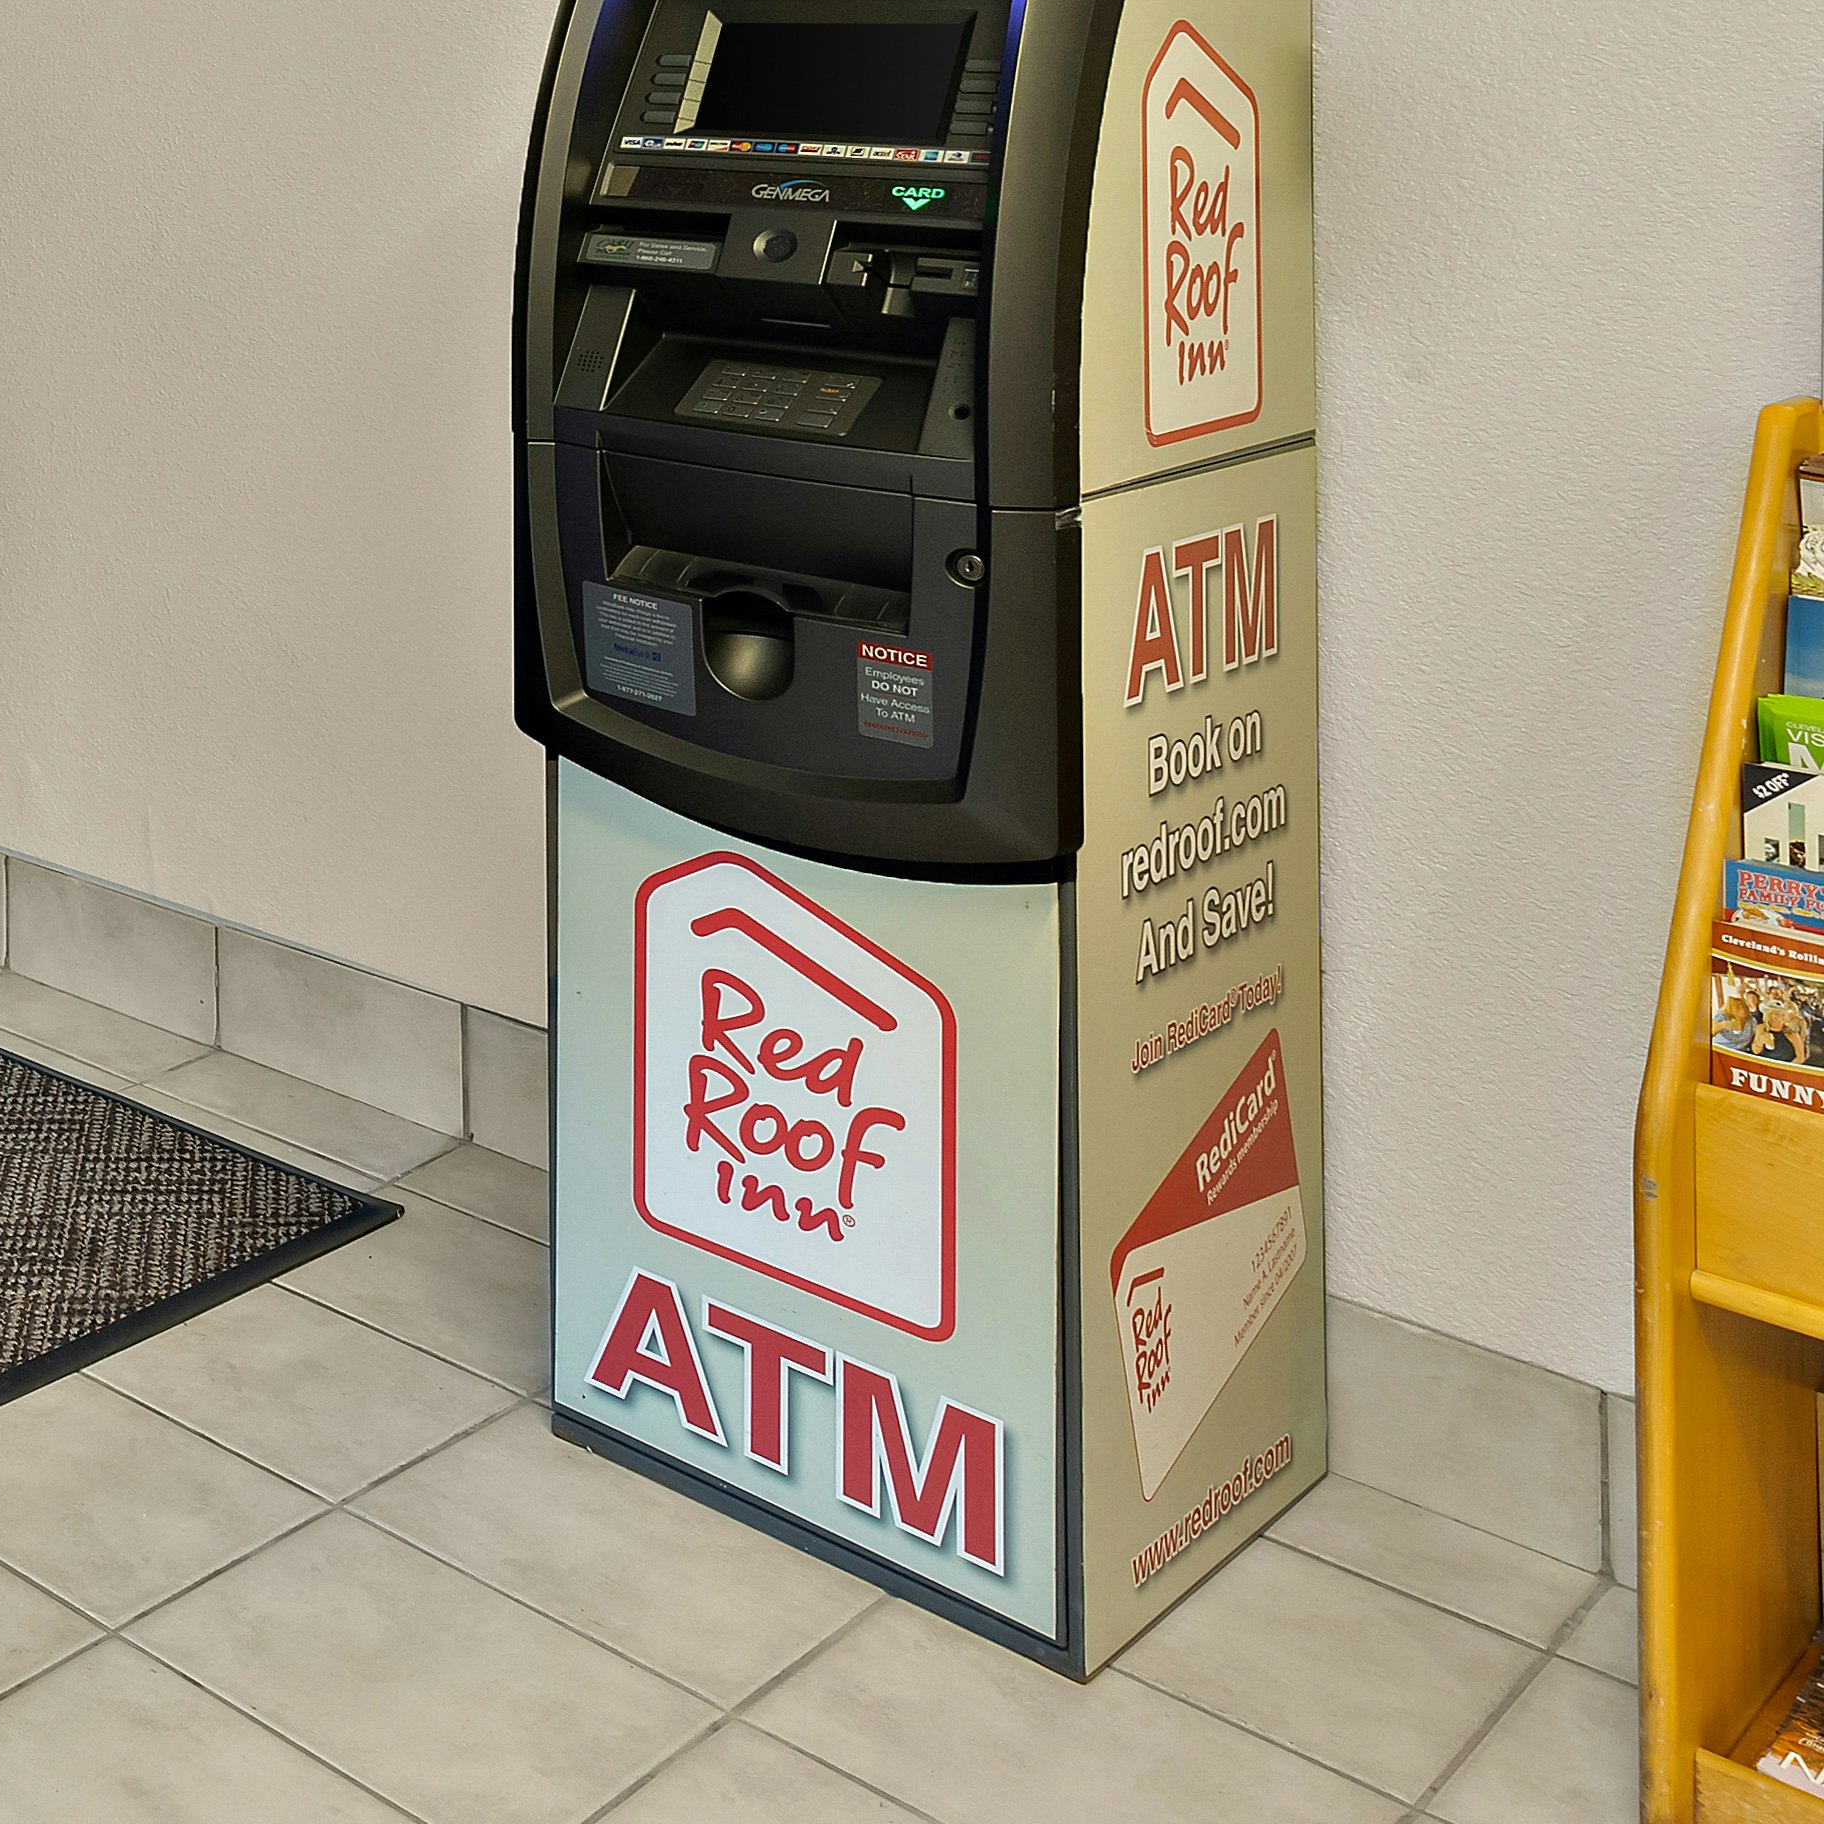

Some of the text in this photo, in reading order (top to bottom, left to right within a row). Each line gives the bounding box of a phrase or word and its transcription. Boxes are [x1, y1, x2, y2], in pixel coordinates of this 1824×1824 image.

[751, 183, 830, 203] GENMEGA
[892, 186, 945, 199] CARD
[895, 151, 916, 160] STAR
[1169, 146, 1230, 242] Red
[1164, 221, 1244, 347] Roof
[613, 593, 658, 610] FEE NOTICE
[1122, 513, 1278, 708] ATM
[861, 643, 928, 667] NOTICE
[865, 666, 925, 686] Employees
[871, 680, 918, 696] DO NOT
[860, 692, 930, 714] Have Access
[875, 707, 915, 723] To ATM
[1148, 708, 1263, 798] Book on
[1752, 783, 1773, 799] $2
[1121, 781, 1287, 900] redroof.com
[1136, 860, 1275, 984] And Save!
[1739, 888, 1798, 906] FAMILY
[1721, 934, 1786, 957] Cleveland's
[700, 968, 864, 1108] Red
[1130, 963, 1284, 1074] Join Today!
[683, 1052, 906, 1208] Roof
[1206, 1099, 1279, 1206] Rewards membership
[1243, 1279, 1262, 1310] Name
[1268, 1227, 1295, 1274] Lastname
[1132, 1286, 1163, 1354] Red
[1234, 1304, 1260, 1348] Member
[1259, 1281, 1275, 1309] since
[1135, 1304, 1172, 1404] Roof
[584, 1266, 1005, 1577] ATM
[1132, 1432, 1292, 1588] www.redroof.com
